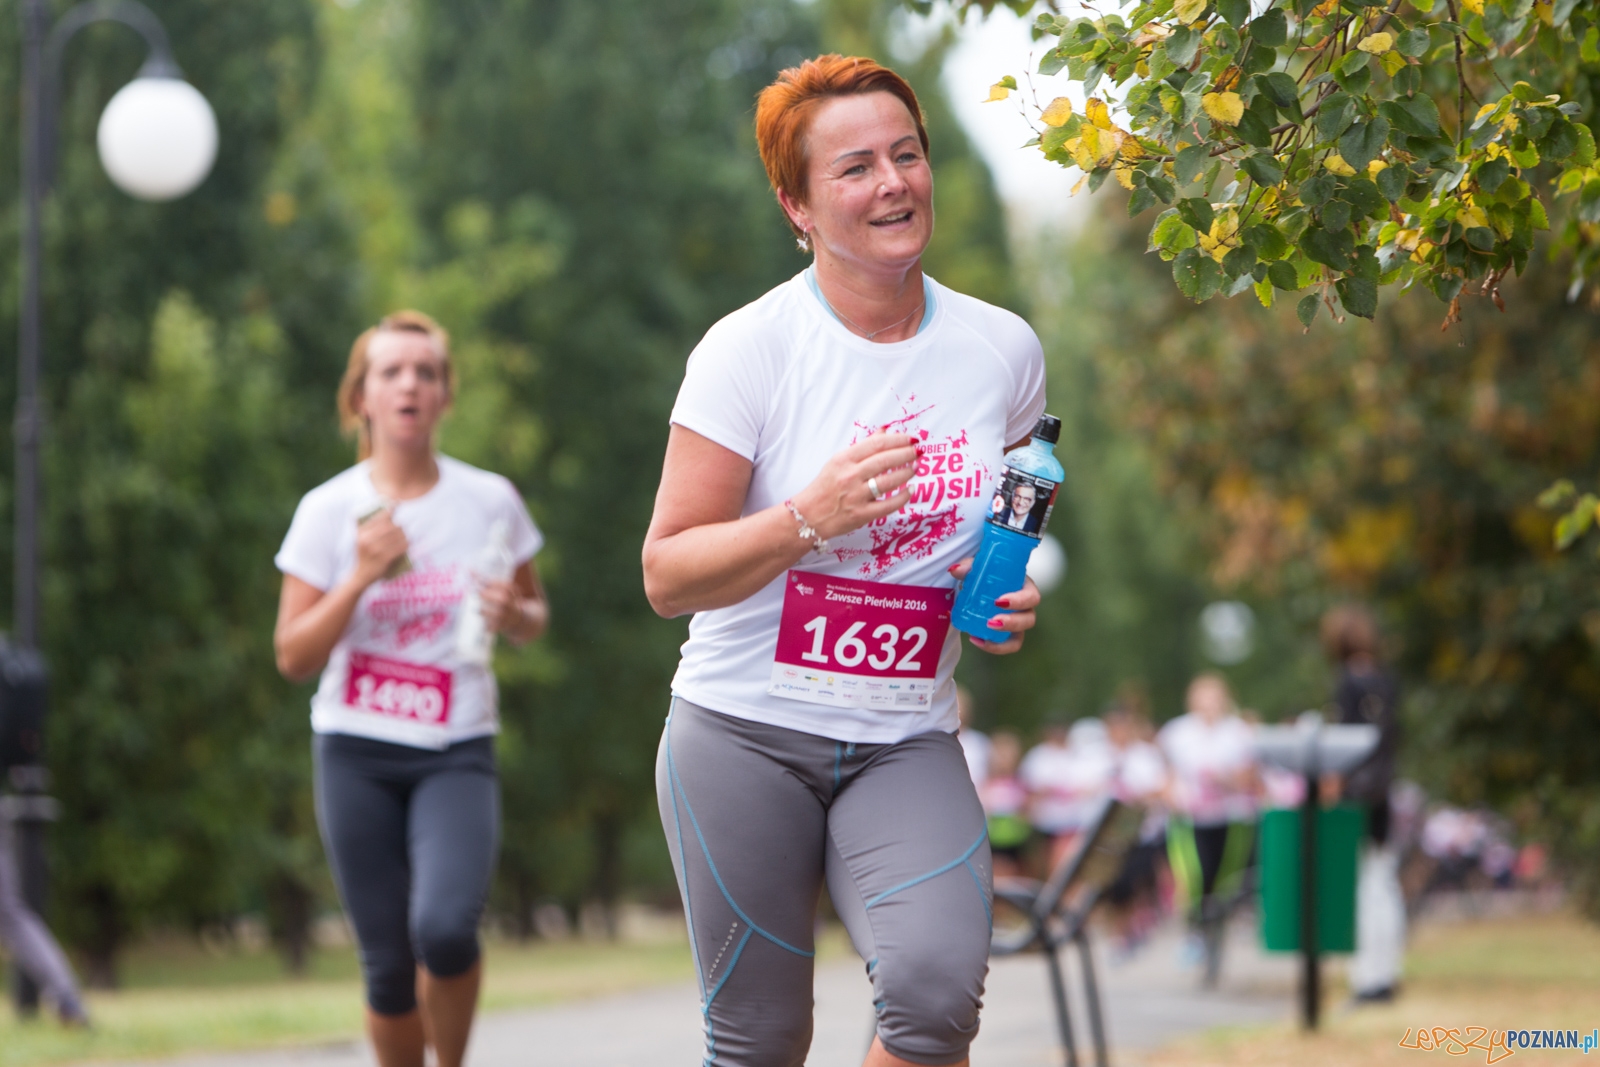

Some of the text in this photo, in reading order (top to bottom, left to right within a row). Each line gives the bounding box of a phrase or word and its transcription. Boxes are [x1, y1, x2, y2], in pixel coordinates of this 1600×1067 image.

[825, 589, 863, 605] Zawsze
[864, 595, 903, 610] Pier(w)si
[903, 599, 927, 611] 2016
[801, 615, 928, 671] 1632
[355, 674, 444, 722] 1490
